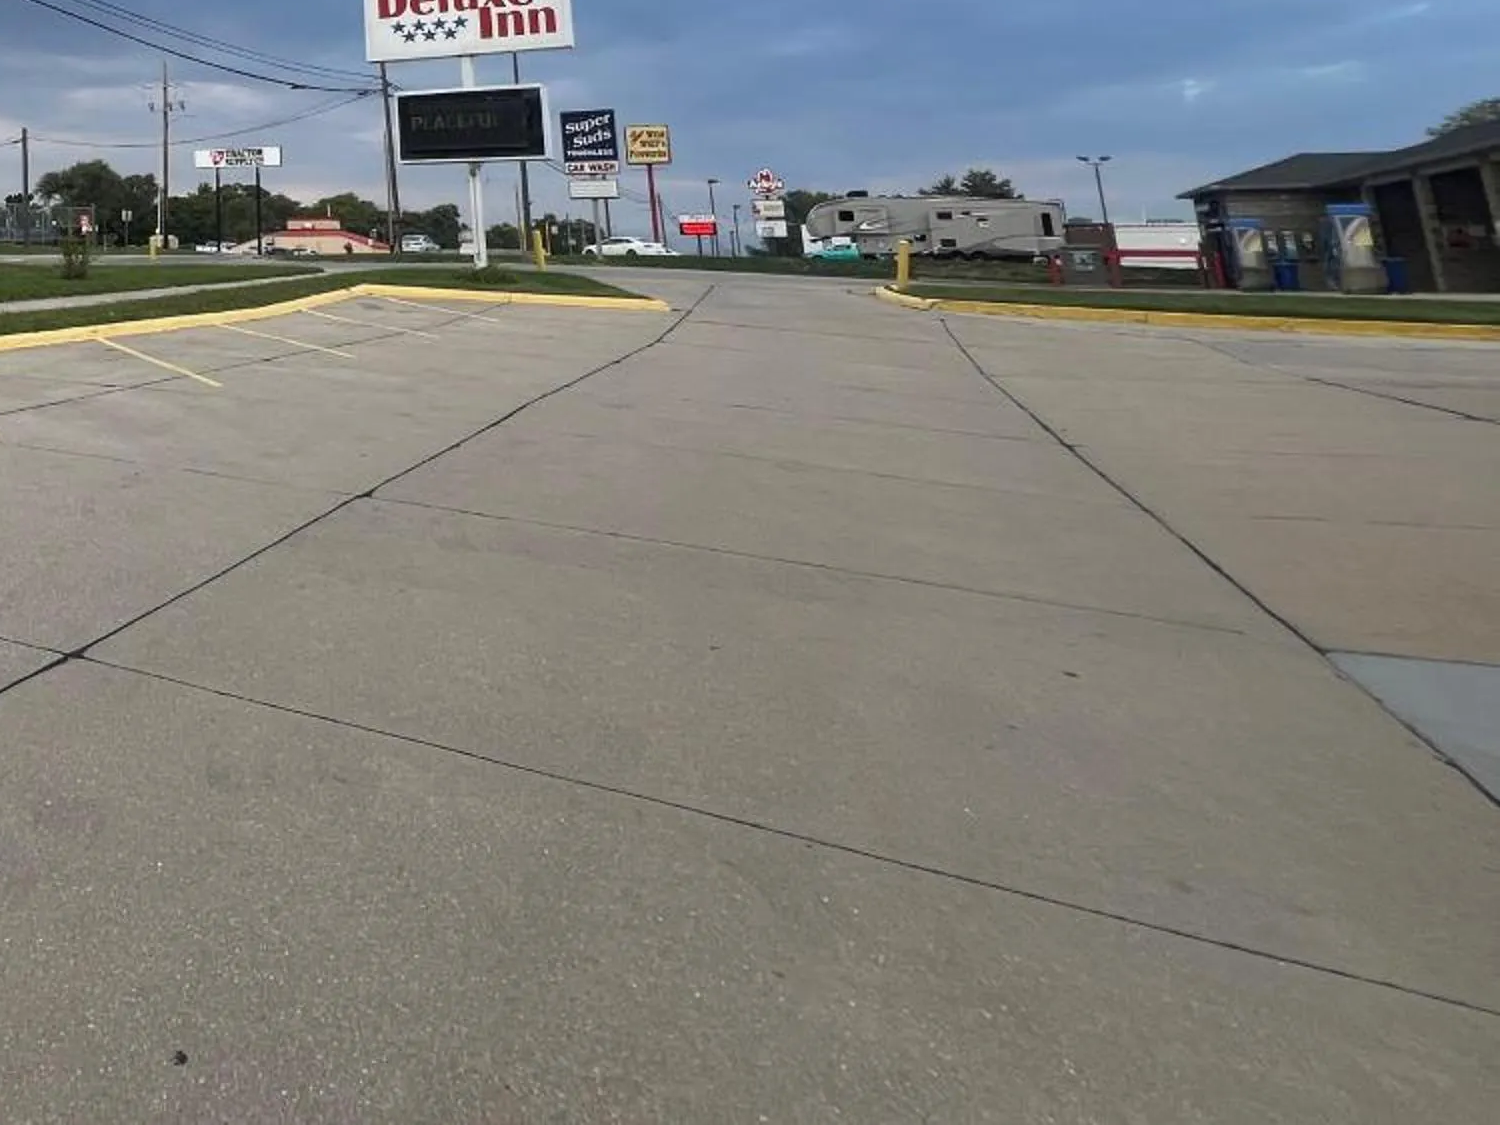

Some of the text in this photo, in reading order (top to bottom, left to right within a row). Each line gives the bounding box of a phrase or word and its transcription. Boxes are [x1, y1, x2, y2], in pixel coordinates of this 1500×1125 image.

[478, 5, 557, 40] Inn
[573, 129, 612, 148] Suds
[567, 162, 616, 172] CAR WASH
